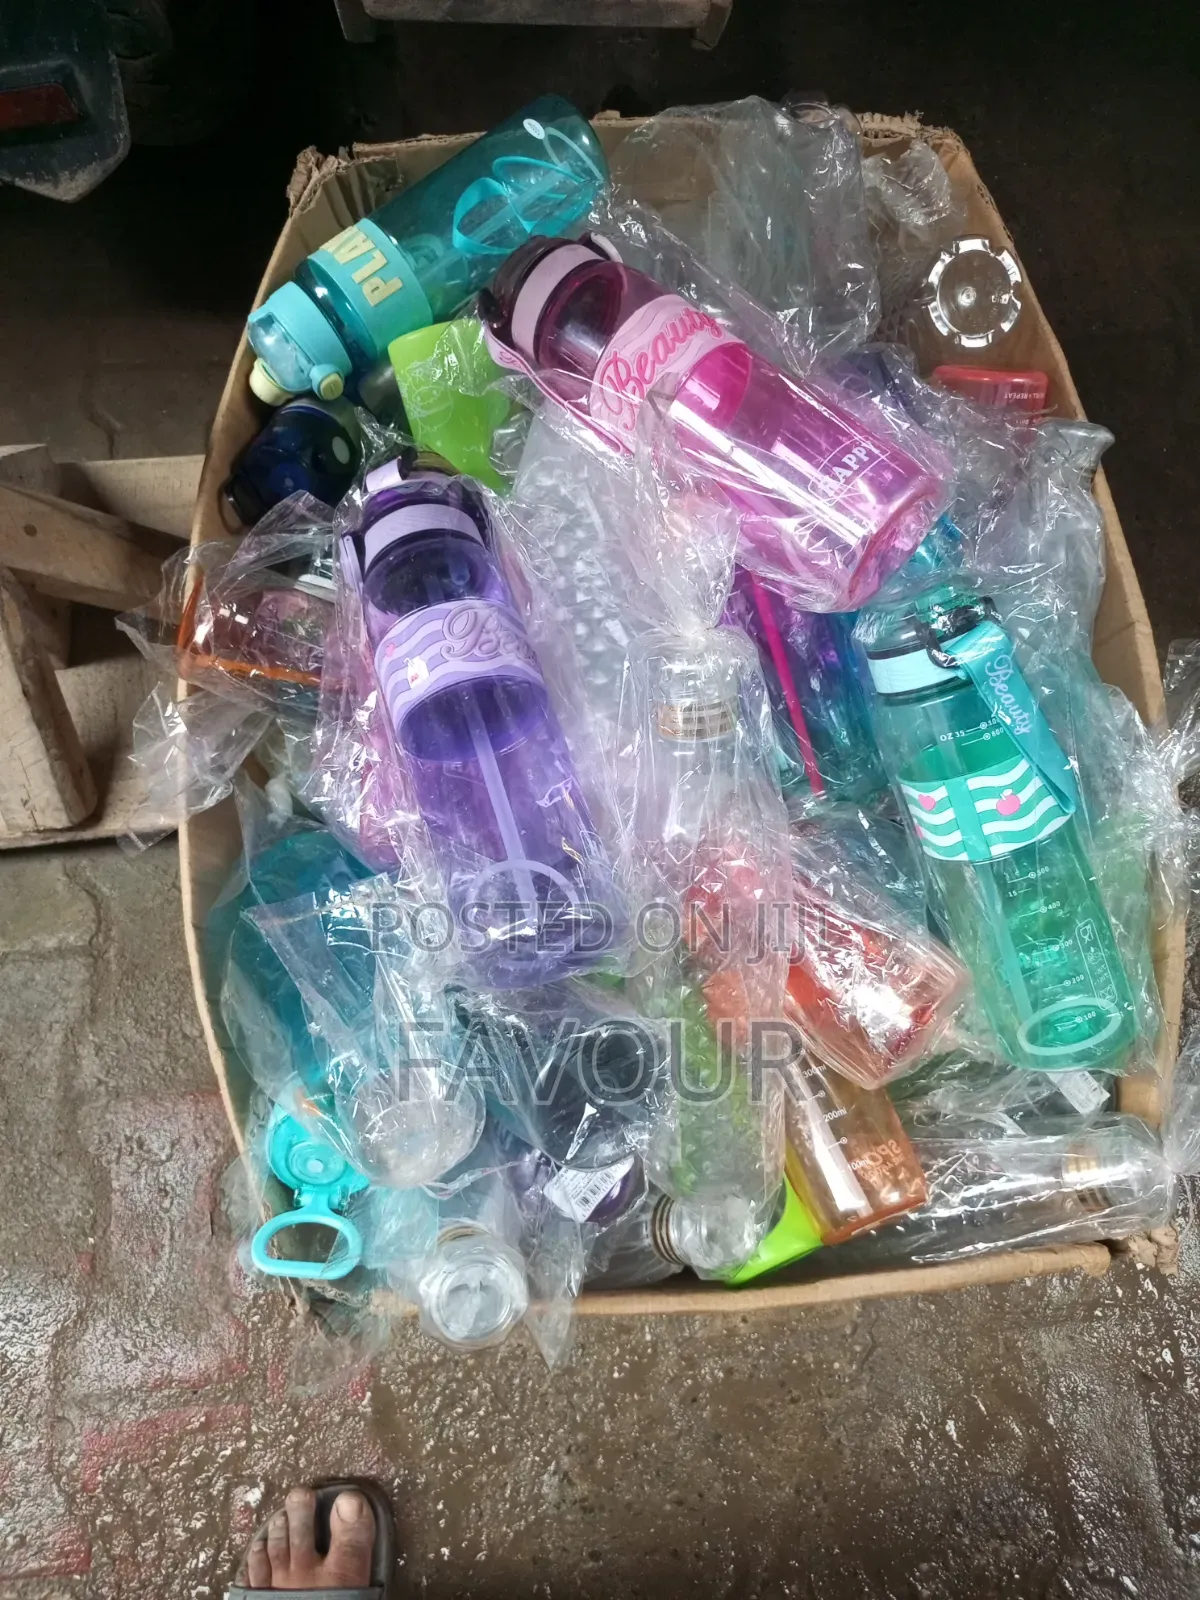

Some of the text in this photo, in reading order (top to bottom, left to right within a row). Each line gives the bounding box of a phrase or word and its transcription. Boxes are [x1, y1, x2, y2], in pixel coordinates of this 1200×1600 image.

[600, 306, 723, 431] Beauty
[817, 441, 881, 498] HAPPY
[984, 654, 1033, 736] Beauty
[940, 732, 954, 742] OZ
[955, 729, 965, 738] 35
[1071, 974, 1085, 984] 200
[1083, 1010, 1097, 1021] 100
[822, 1107, 848, 1122] 200ml
